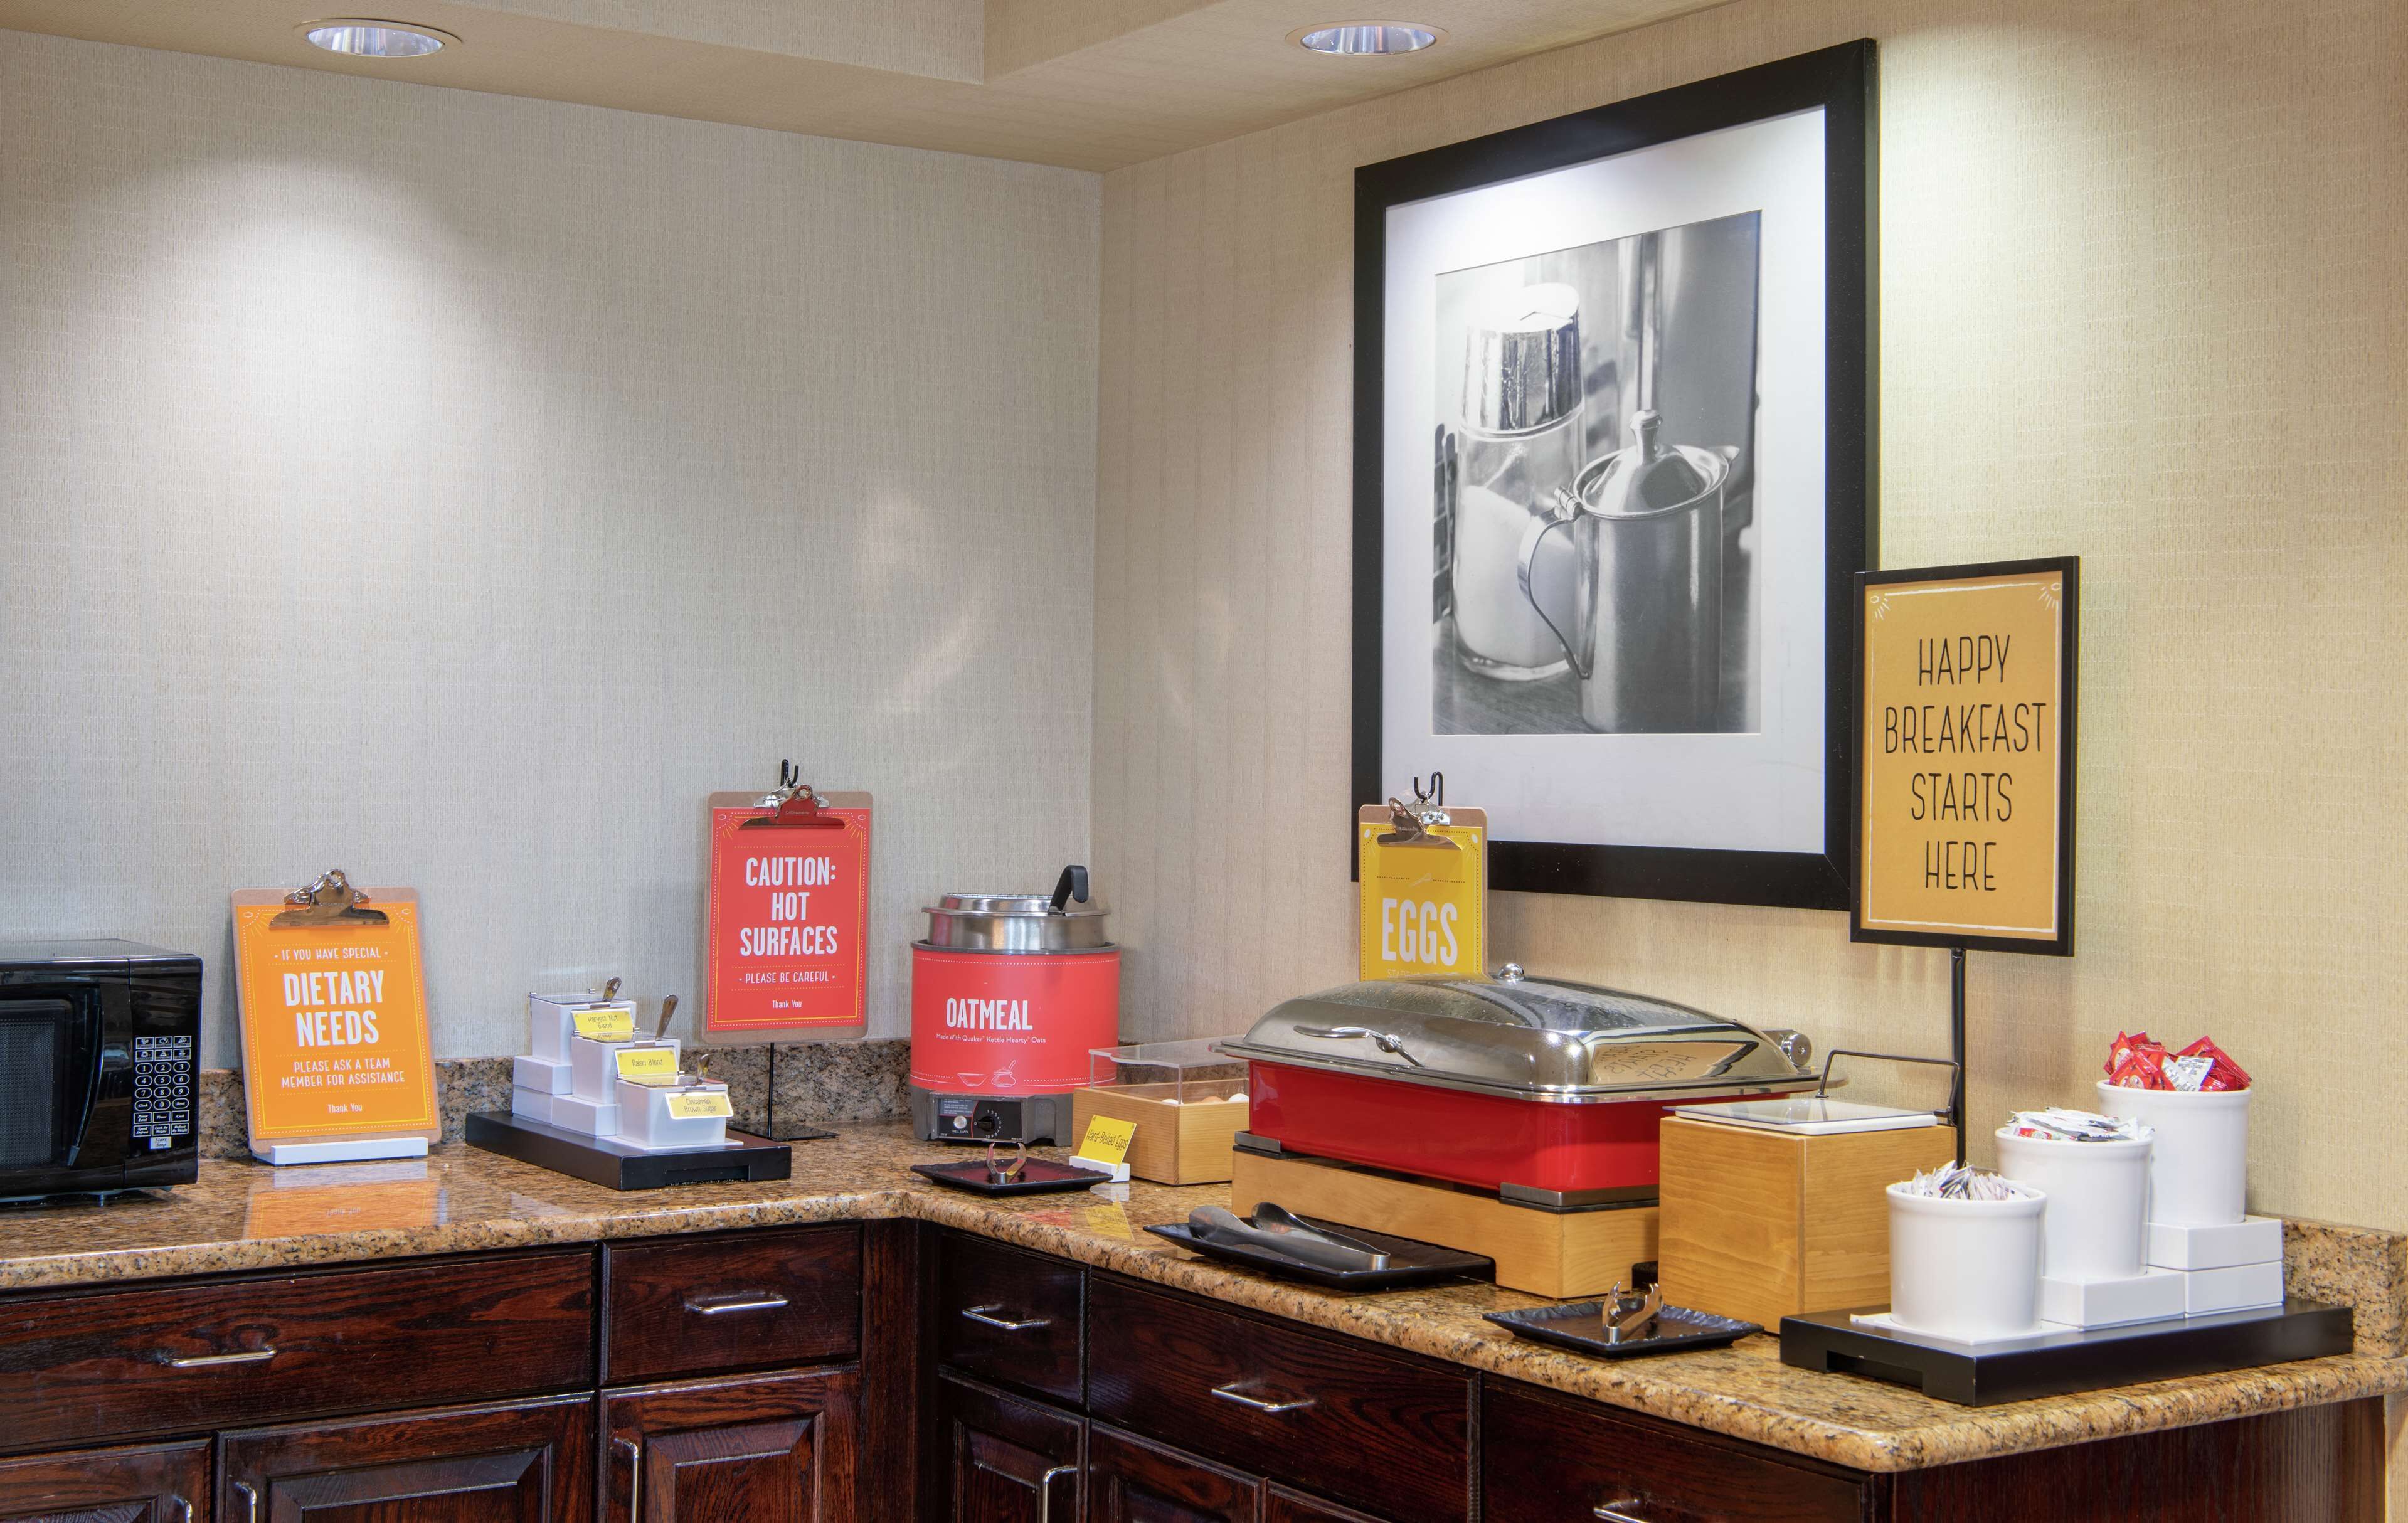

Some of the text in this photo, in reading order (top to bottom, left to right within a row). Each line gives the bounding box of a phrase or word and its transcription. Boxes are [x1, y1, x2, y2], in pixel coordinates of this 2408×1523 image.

[1919, 634, 2010, 686] HAPPY
[1886, 703, 2047, 754] BREAKFAST
[1911, 773, 2013, 822] STARTS
[745, 857, 836, 887] CAUTION:
[1925, 841, 1997, 891] HERE
[771, 891, 810, 921] HOT
[740, 925, 838, 957] SURFACES
[1382, 898, 1458, 967] EGGS
[282, 947, 381, 960] IF YOU HAVE SPECIAL
[284, 970, 384, 1006] DIETARY
[745, 971, 829, 984] PLEASE BE CAREFUL
[772, 999, 802, 1009] Thank You
[947, 997, 1033, 1031] OATMEAL
[296, 1009, 379, 1047] NEEDS
[294, 1058, 390, 1073] PLEASE ASK A TEAM
[649, 1058, 663, 1066] Blend
[281, 1071, 405, 1088] MEMBER FOR ASSISTANCE
[327, 1103, 363, 1113] Thank You
[1086, 1128, 1128, 1151] Hard-Boiled Eggs
